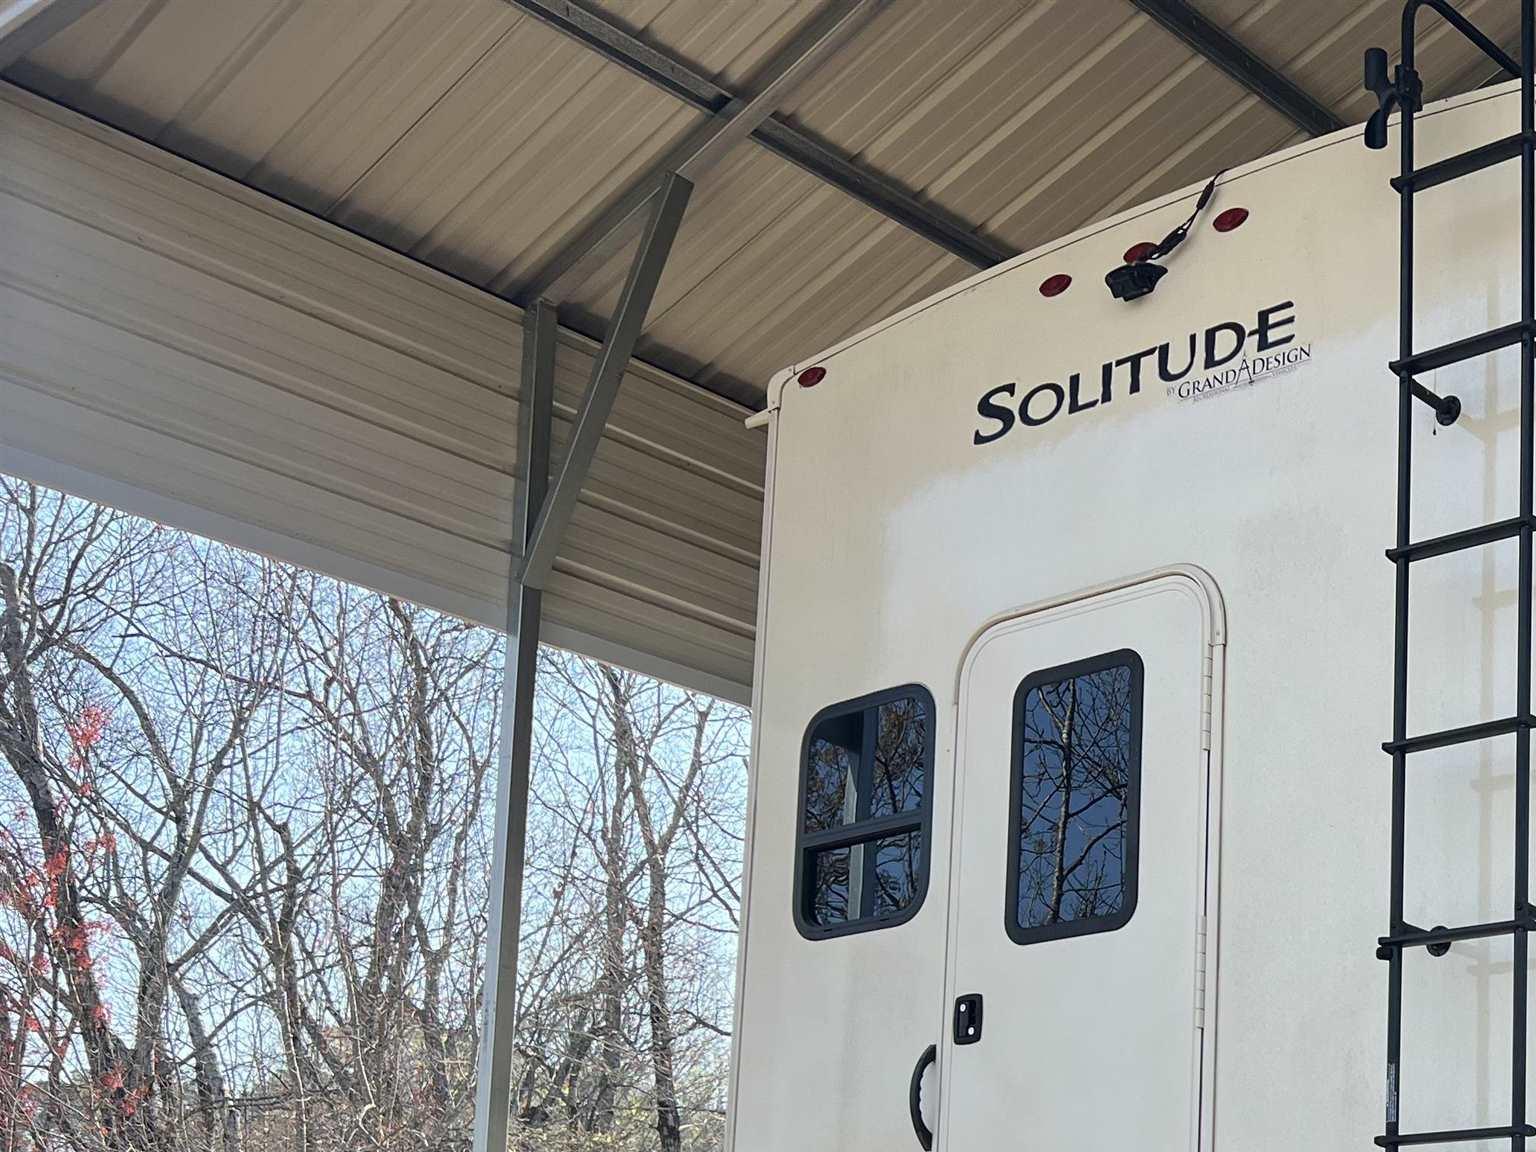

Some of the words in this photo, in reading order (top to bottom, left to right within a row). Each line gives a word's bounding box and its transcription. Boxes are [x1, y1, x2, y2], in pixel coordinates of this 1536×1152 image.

[973, 300, 1296, 446] SOLITUDE
[1178, 368, 1237, 399] GRAND
[1252, 343, 1312, 376] DESIGN
